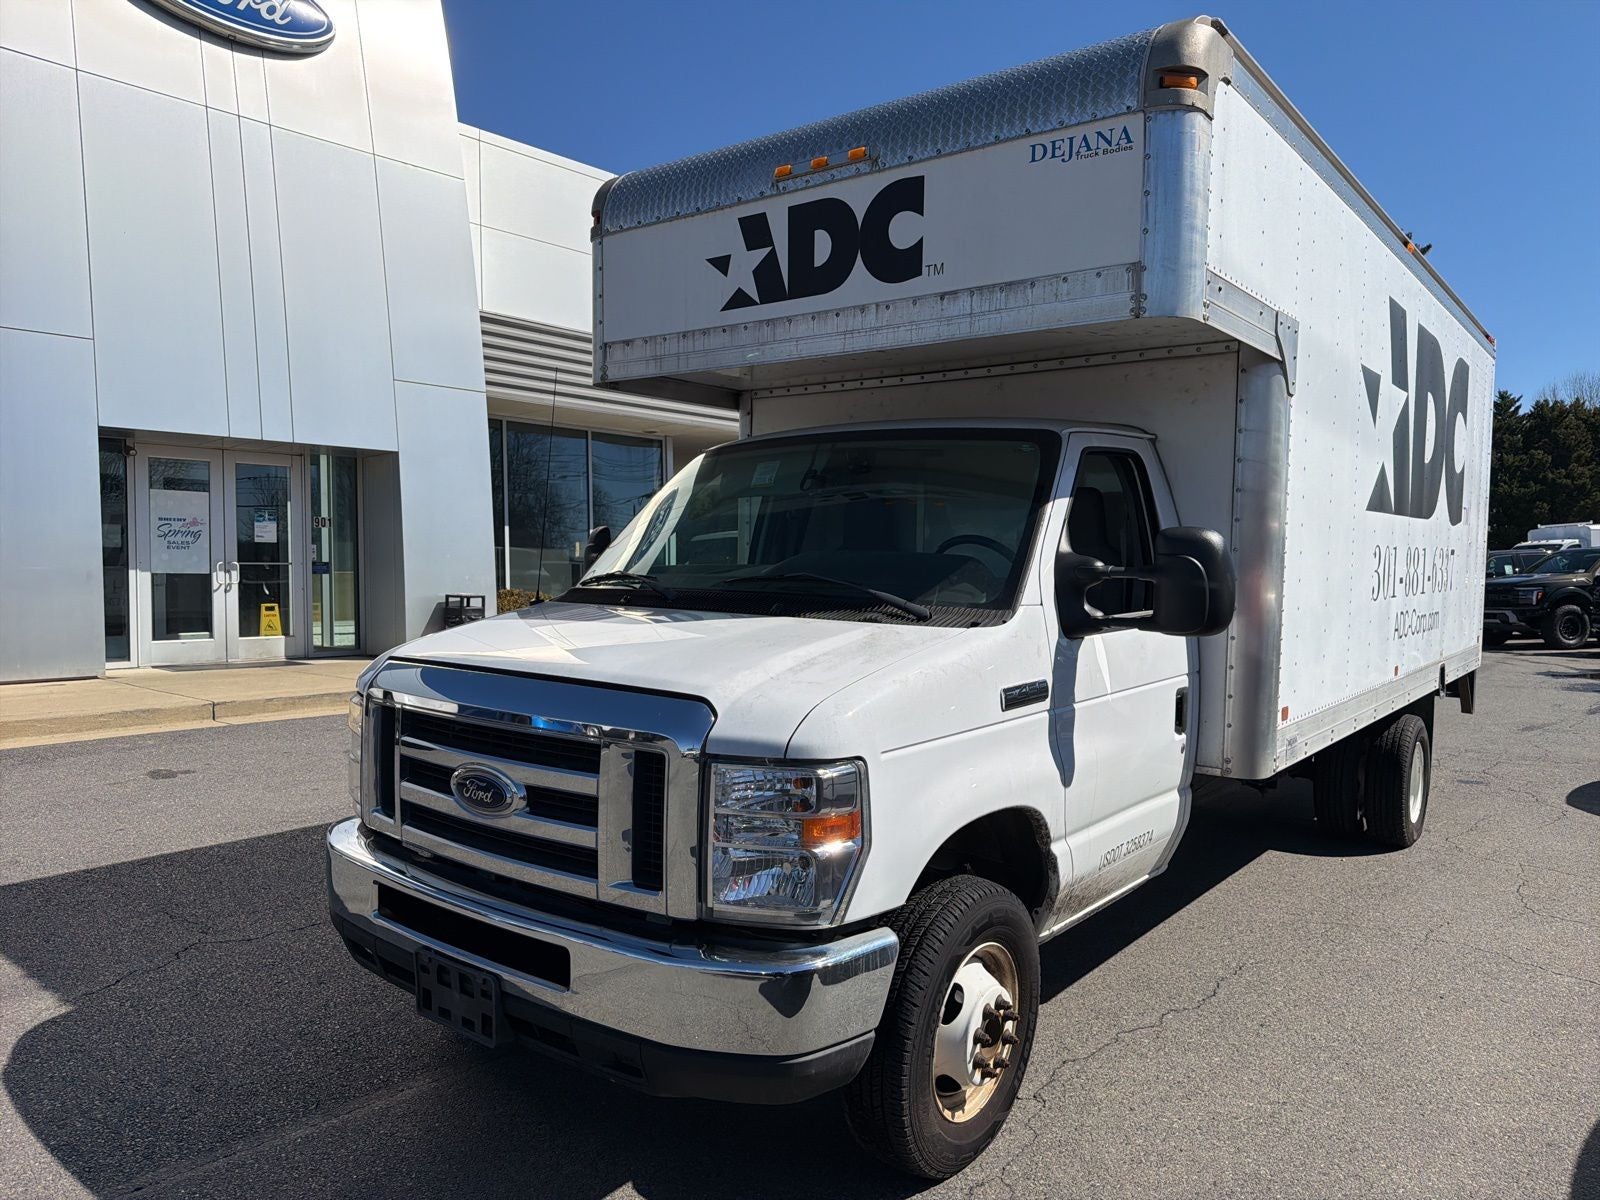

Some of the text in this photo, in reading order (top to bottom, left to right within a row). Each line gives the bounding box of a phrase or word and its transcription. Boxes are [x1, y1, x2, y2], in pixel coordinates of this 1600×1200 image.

[1028, 124, 1134, 164] DEJANA
[1075, 144, 1134, 161] Truck Bodies
[705, 175, 945, 312] ADC TM
[1361, 295, 1470, 527] ADC
[157, 522, 202, 544] Spring
[1371, 544, 1455, 602] 301-881-6337
[463, 778, 494, 804] Ford
[1098, 843, 1124, 870] USDOT
